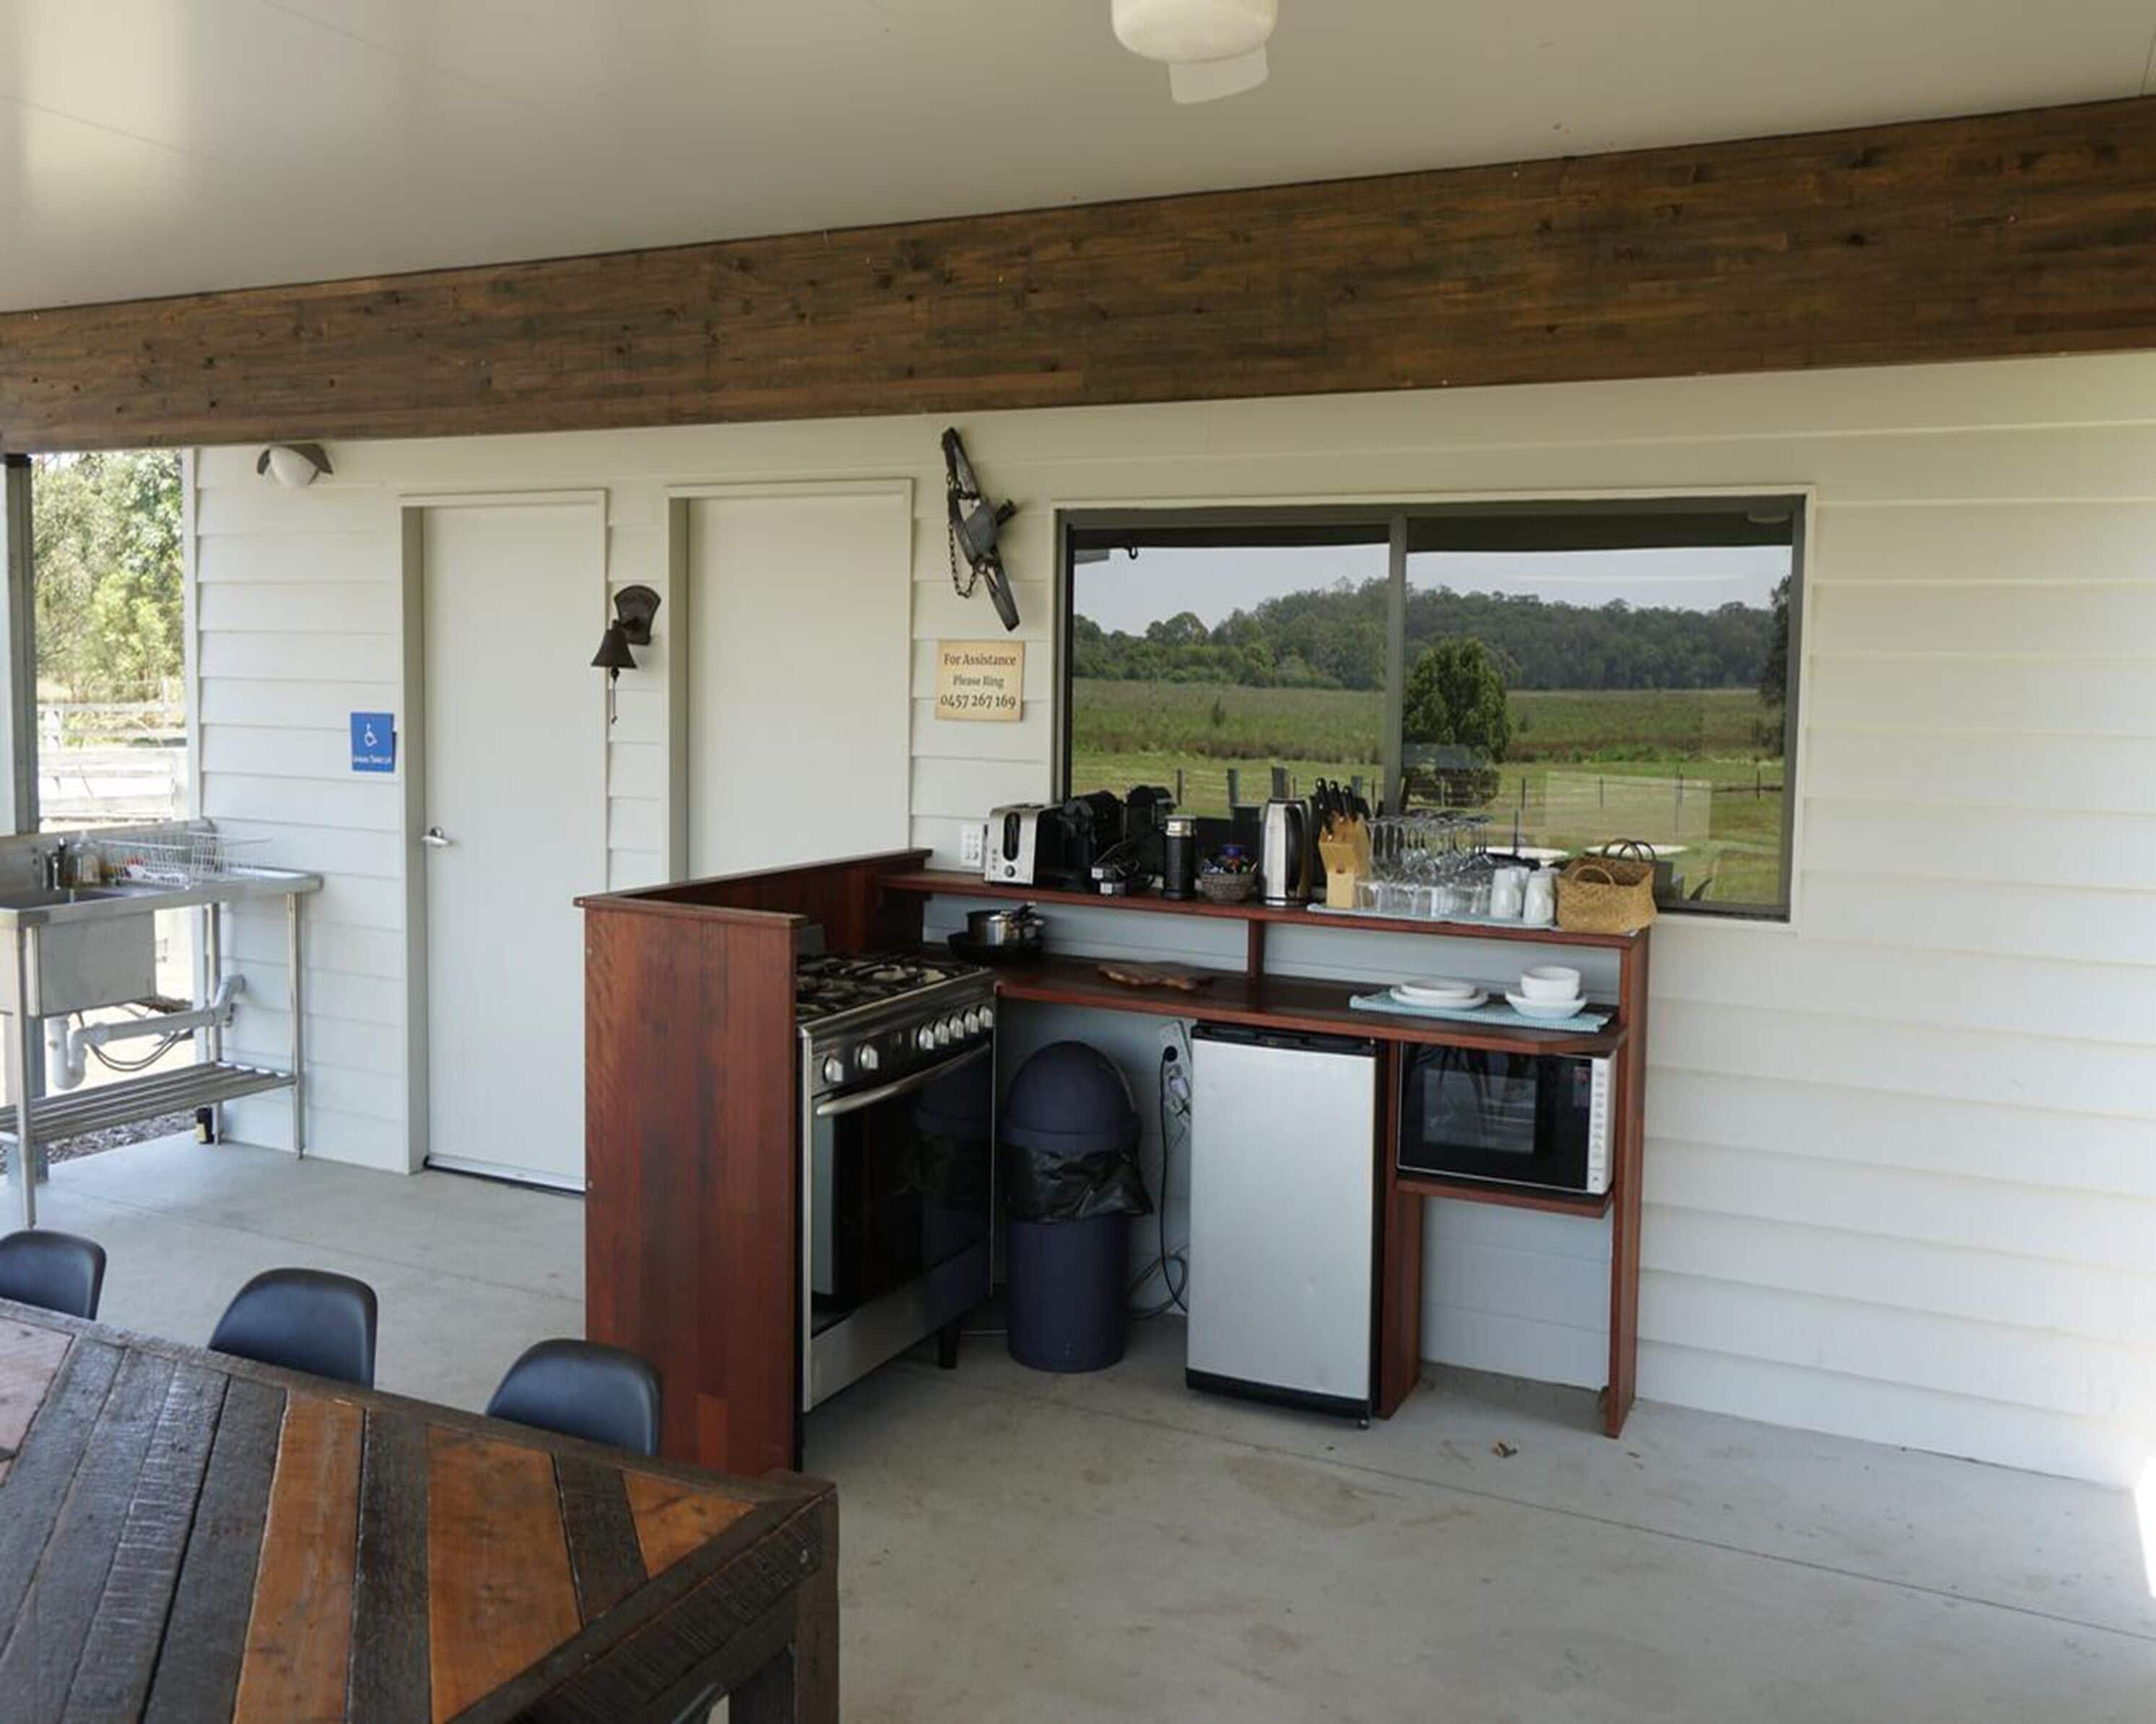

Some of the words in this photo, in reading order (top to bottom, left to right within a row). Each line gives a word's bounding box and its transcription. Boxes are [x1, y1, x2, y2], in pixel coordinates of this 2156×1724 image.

[944, 653, 961, 665] For
[962, 653, 1017, 665] Assistance
[940, 695, 969, 708] 0457
[971, 693, 993, 708] 267
[996, 694, 1016, 709] 169
